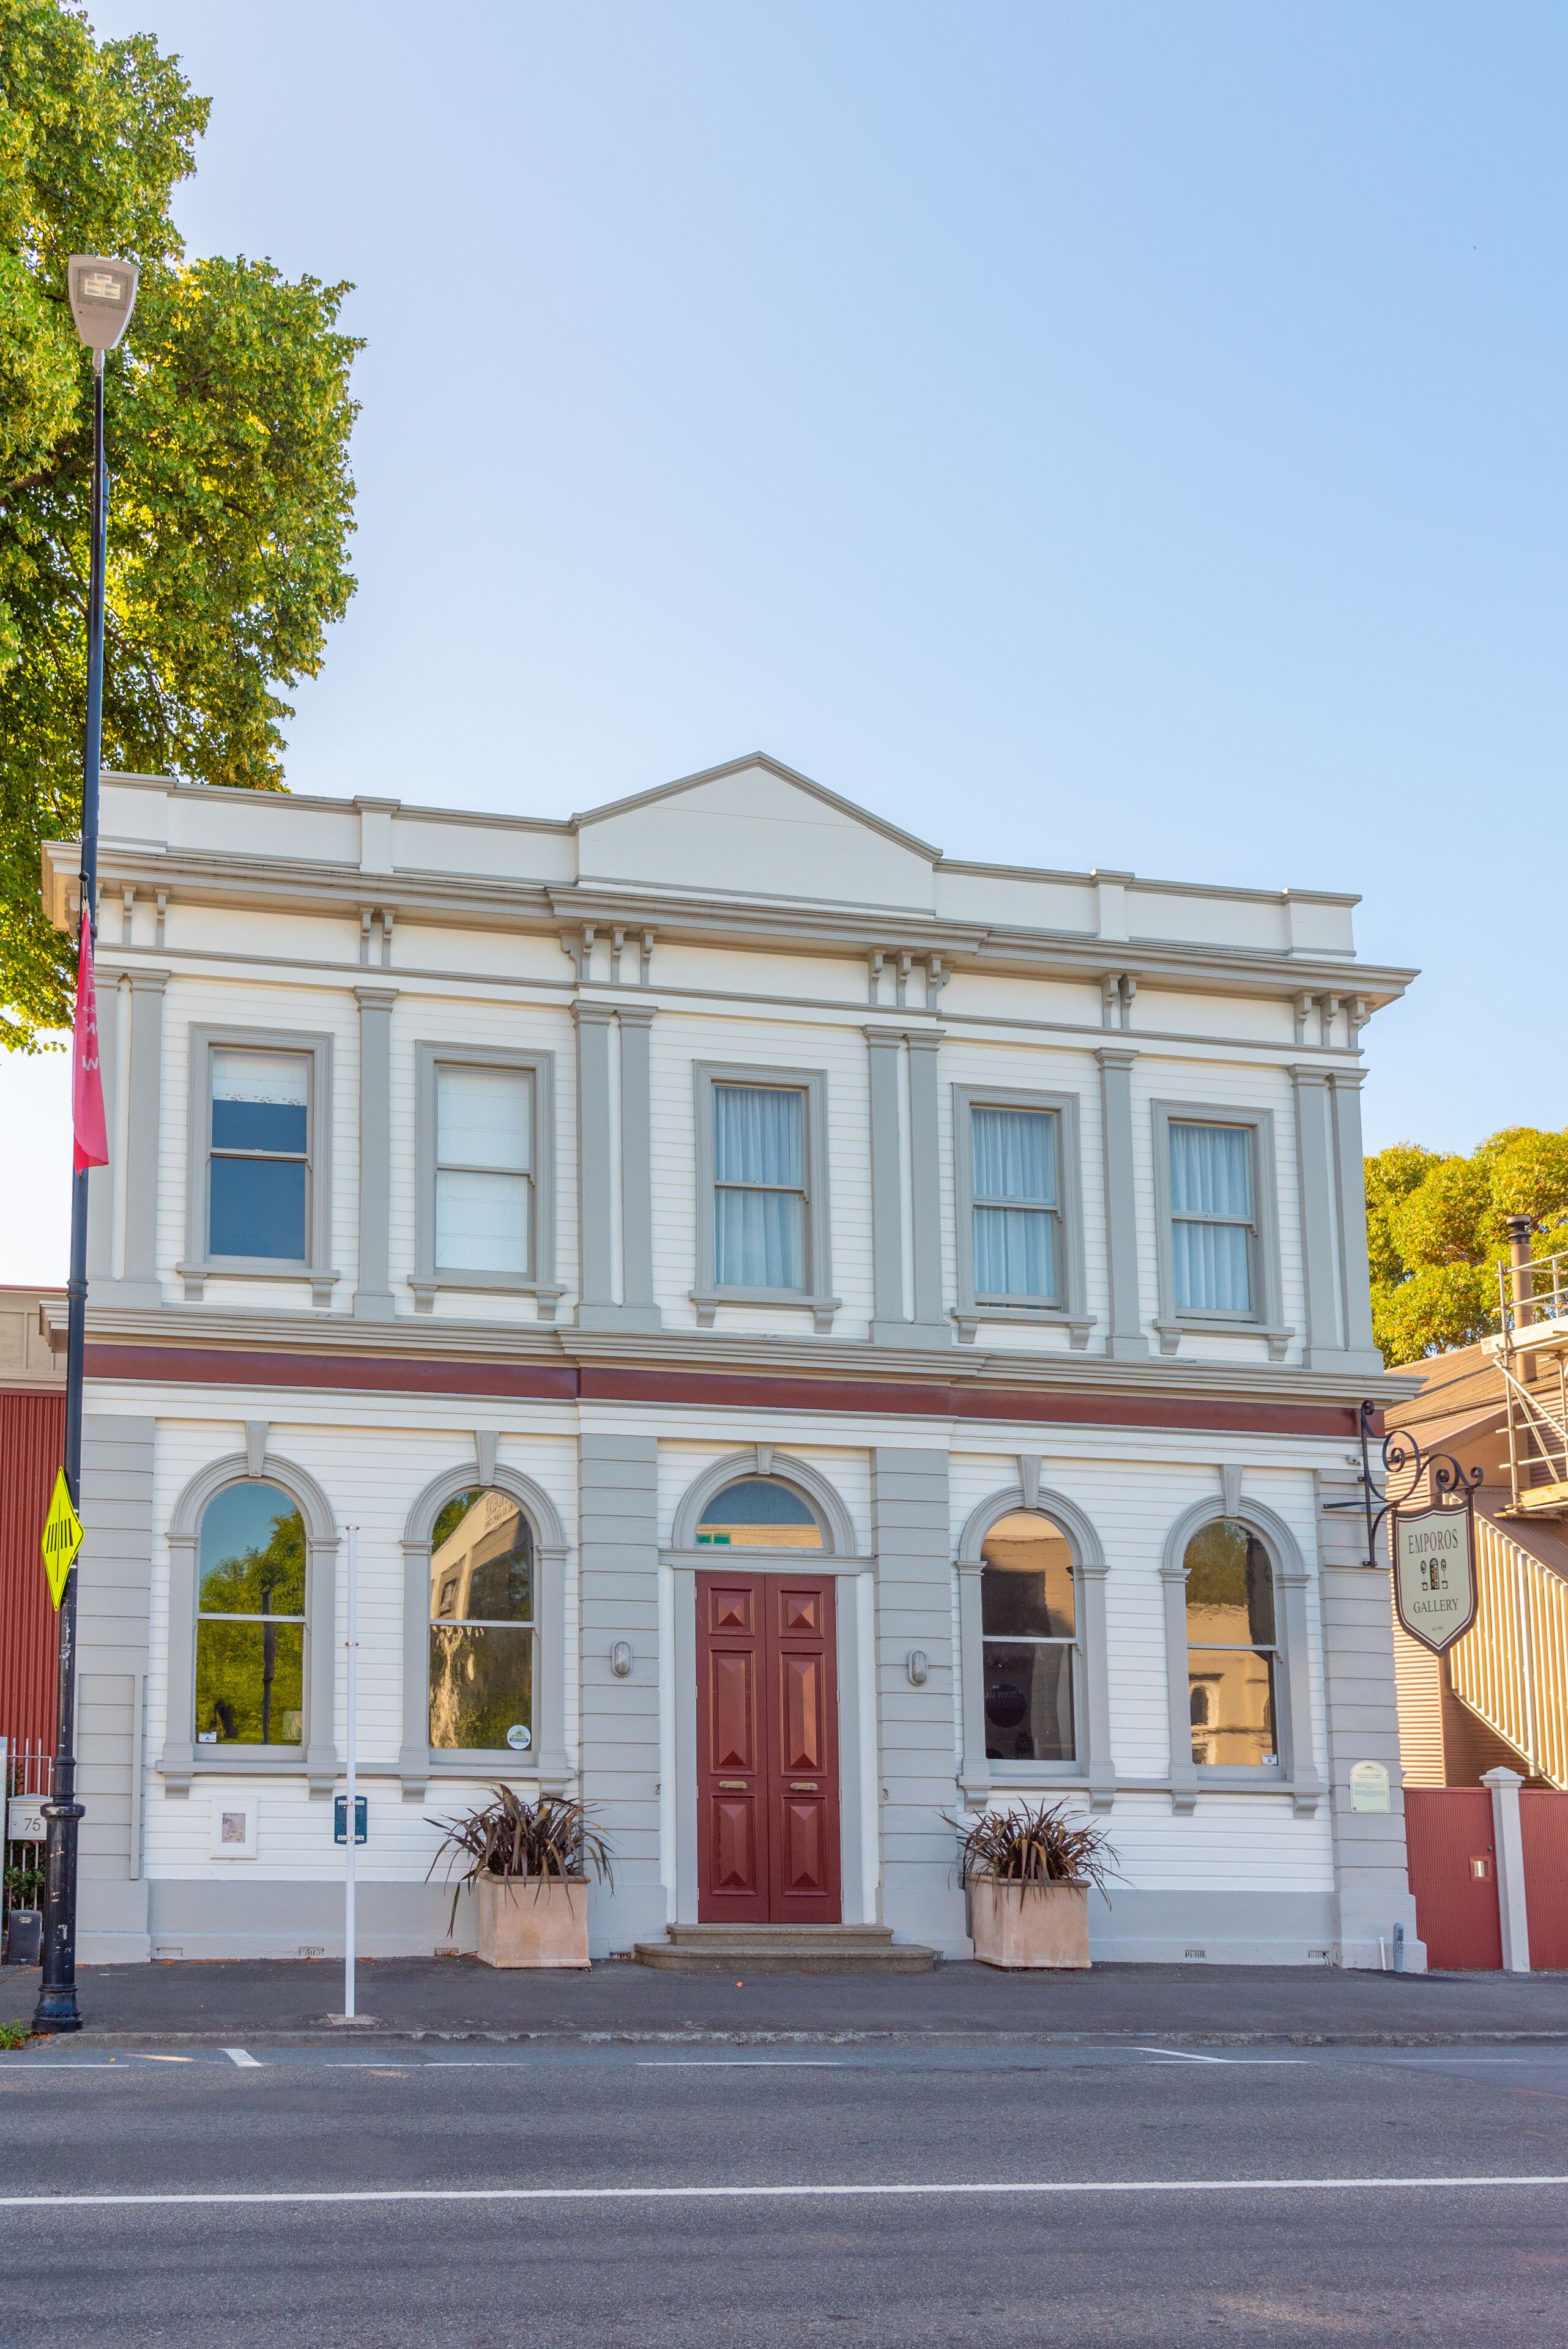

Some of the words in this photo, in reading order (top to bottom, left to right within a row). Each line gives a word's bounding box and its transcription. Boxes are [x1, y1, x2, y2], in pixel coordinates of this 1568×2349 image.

[1408, 1529, 1458, 1554] EMPOROS
[1413, 1598, 1459, 1613] GALLERY
[24, 1817, 41, 1831] 75
